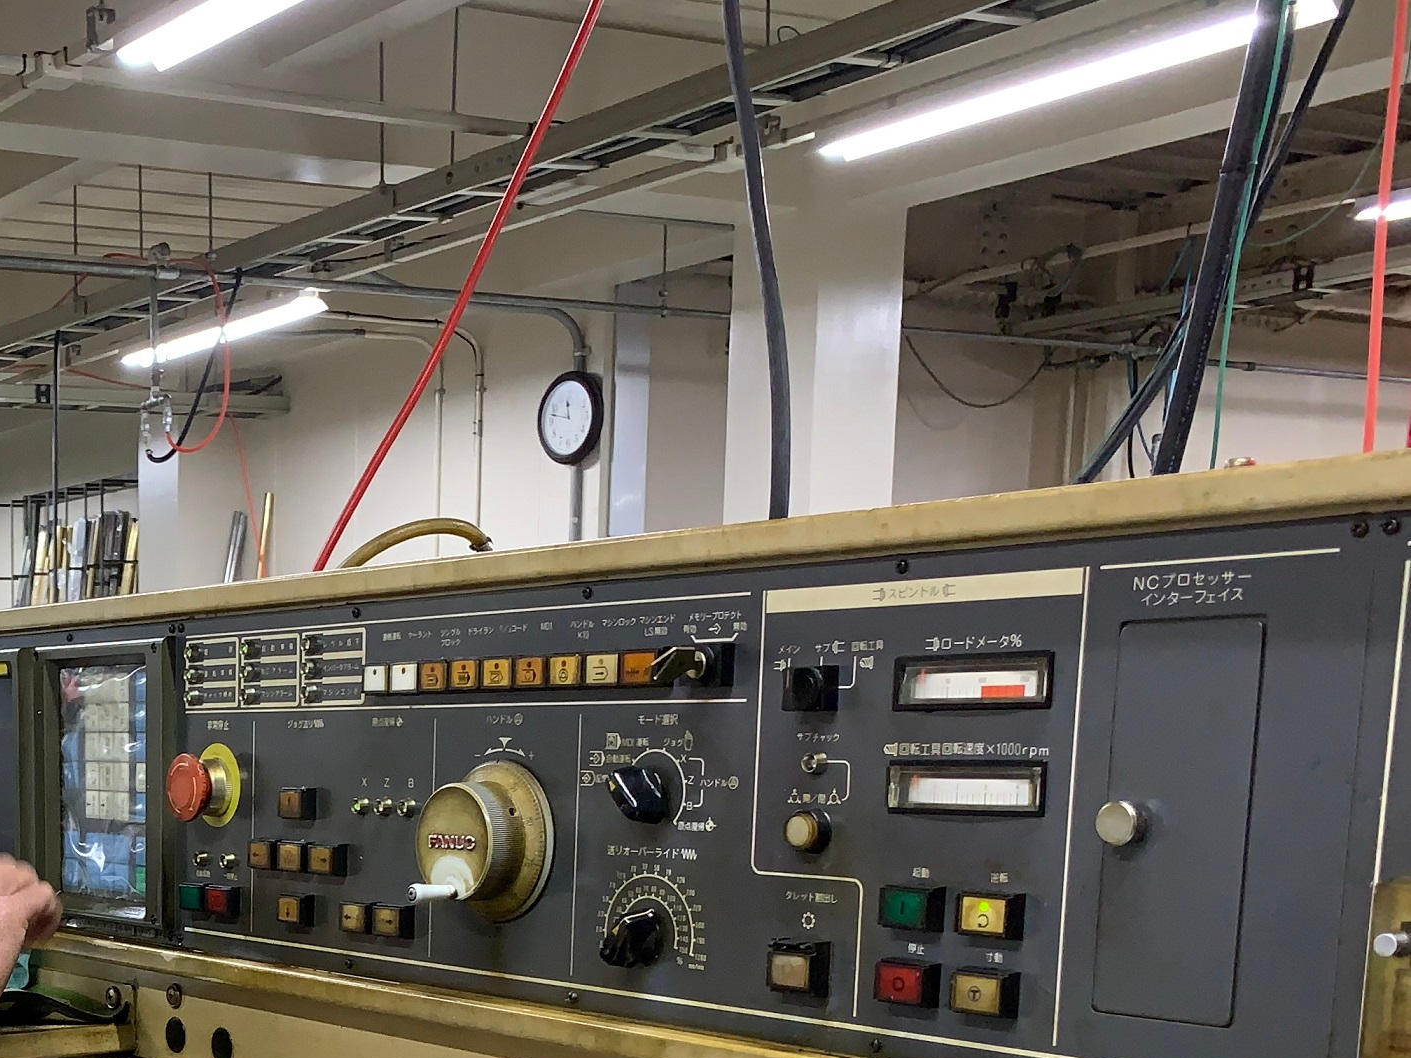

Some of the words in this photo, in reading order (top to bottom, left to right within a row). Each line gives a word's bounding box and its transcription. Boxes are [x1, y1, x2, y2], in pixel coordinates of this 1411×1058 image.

[1133, 571, 1252, 591] NCプロセッサー
[889, 585, 939, 599] スピンドル
[1141, 588, 1244, 606] インターフェイス
[428, 834, 476, 850] FANUC
